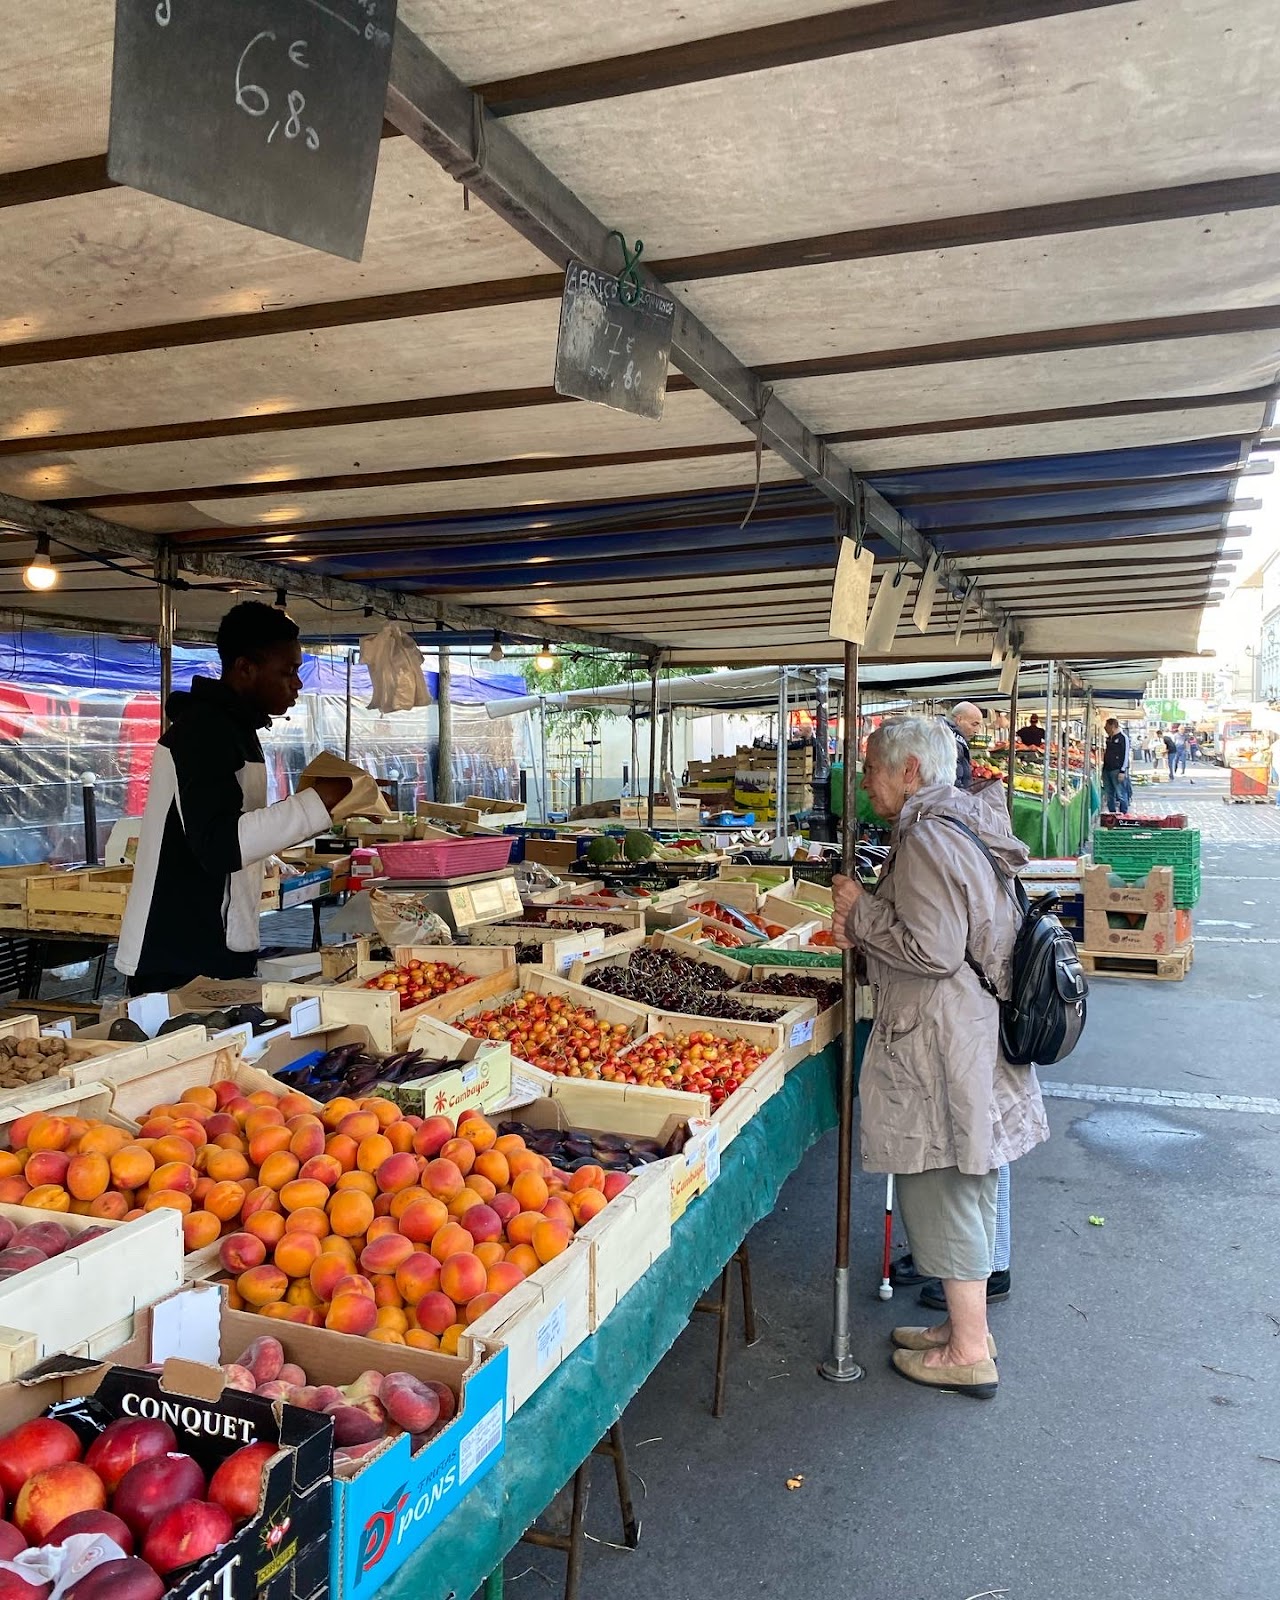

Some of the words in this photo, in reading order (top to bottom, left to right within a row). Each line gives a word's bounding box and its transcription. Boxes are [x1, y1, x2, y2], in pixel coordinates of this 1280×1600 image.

[448, 1078, 490, 1108] Cambayas
[121, 1392, 255, 1441] CONQUET
[260, 1544, 296, 1581] CONQUET
